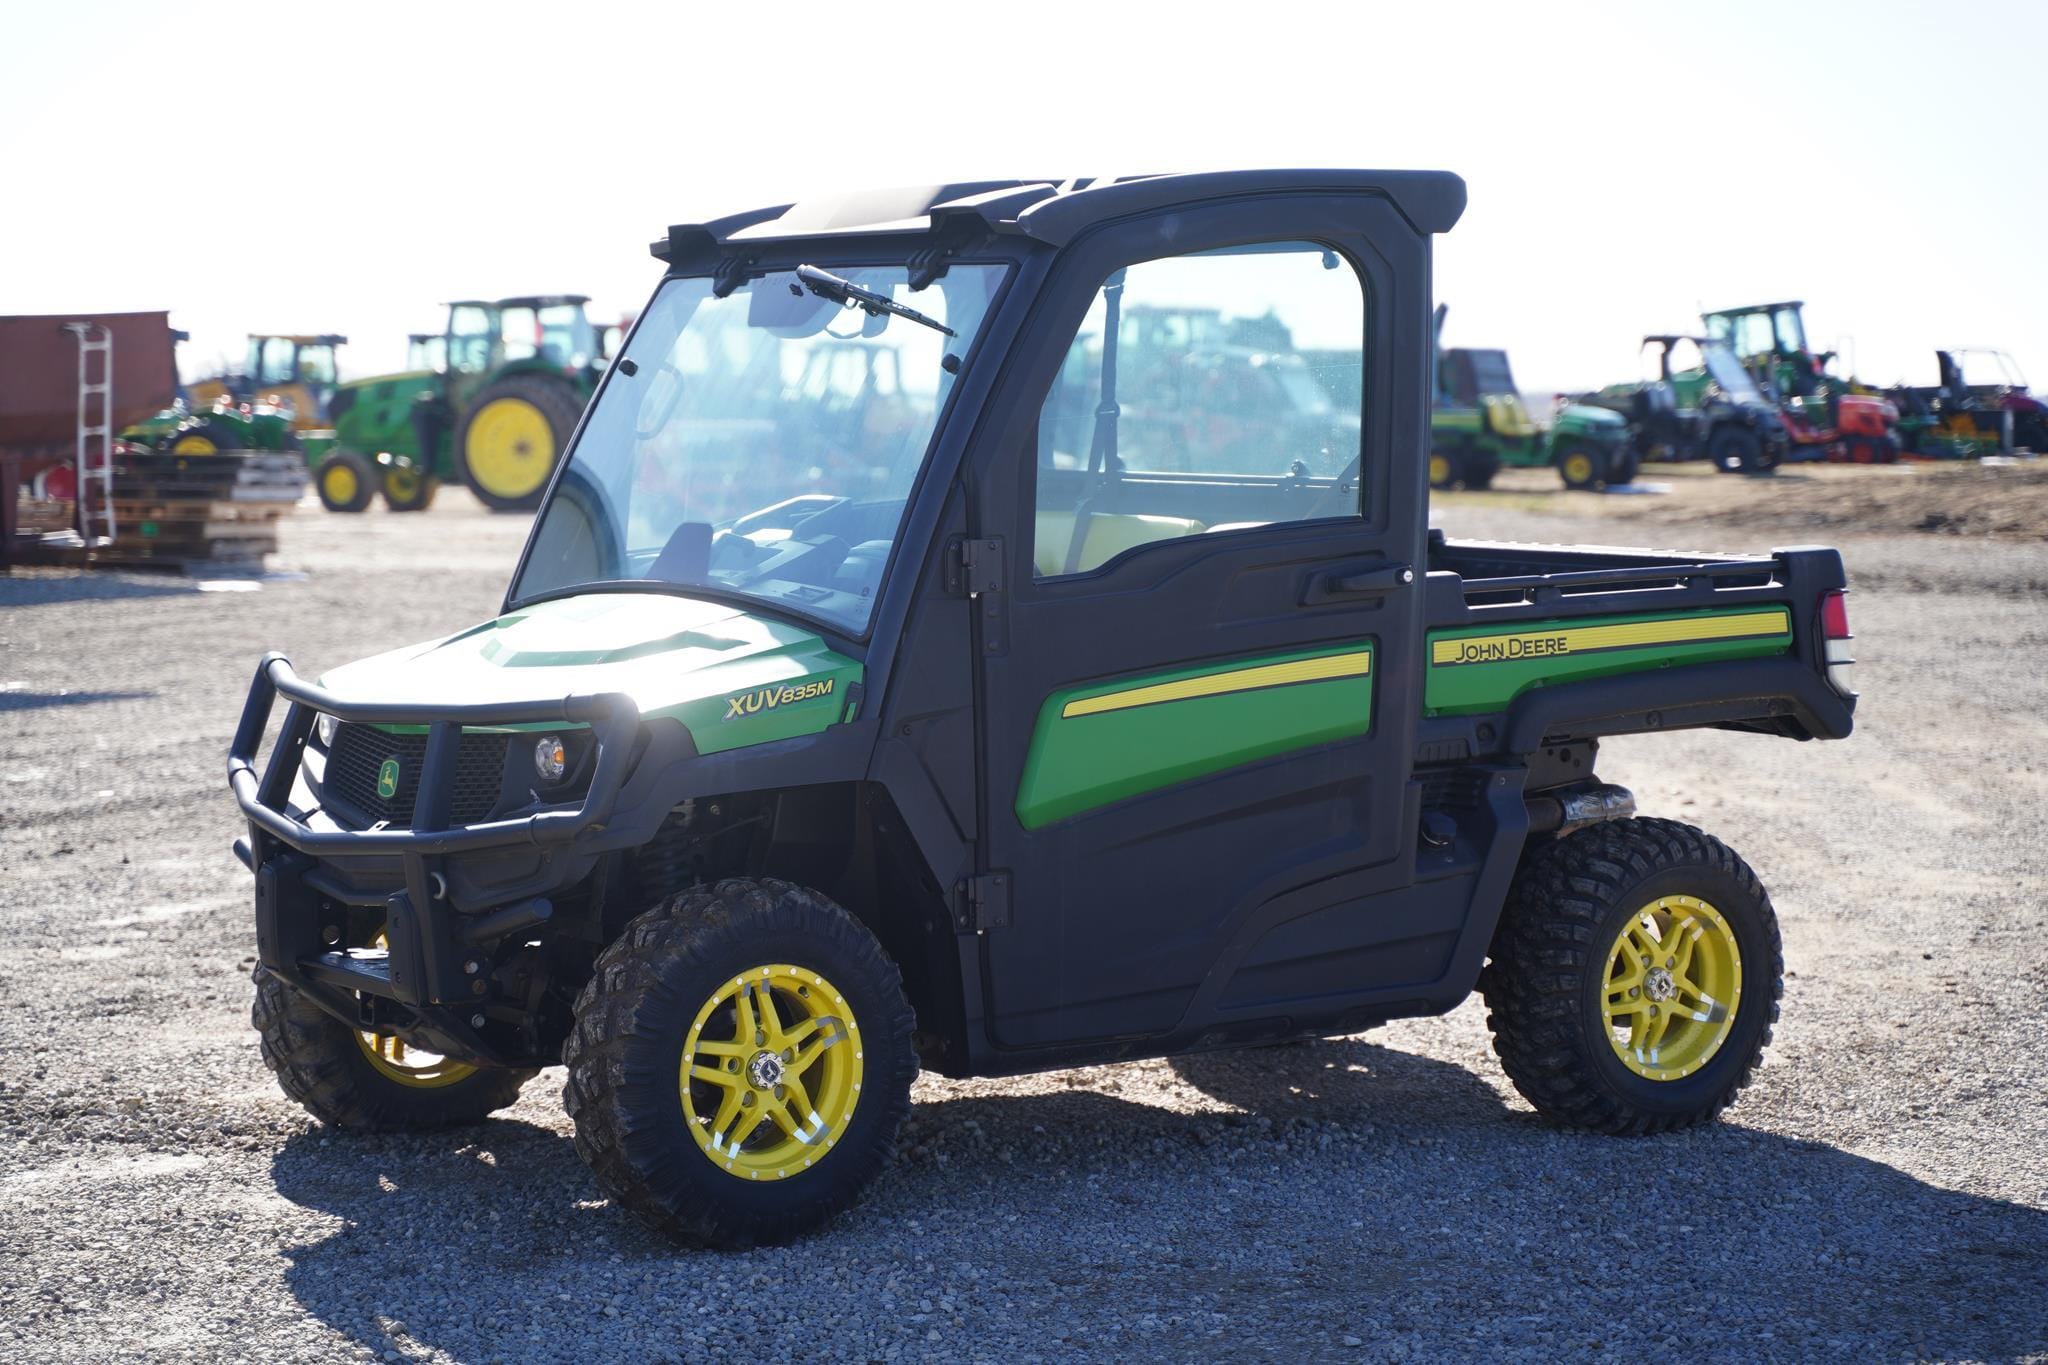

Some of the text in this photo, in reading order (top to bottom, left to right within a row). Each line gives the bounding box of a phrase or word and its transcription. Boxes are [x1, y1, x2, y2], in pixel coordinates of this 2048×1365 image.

[1455, 637, 1568, 662] JOHN DEERE
[725, 679, 834, 720] XUV835M
